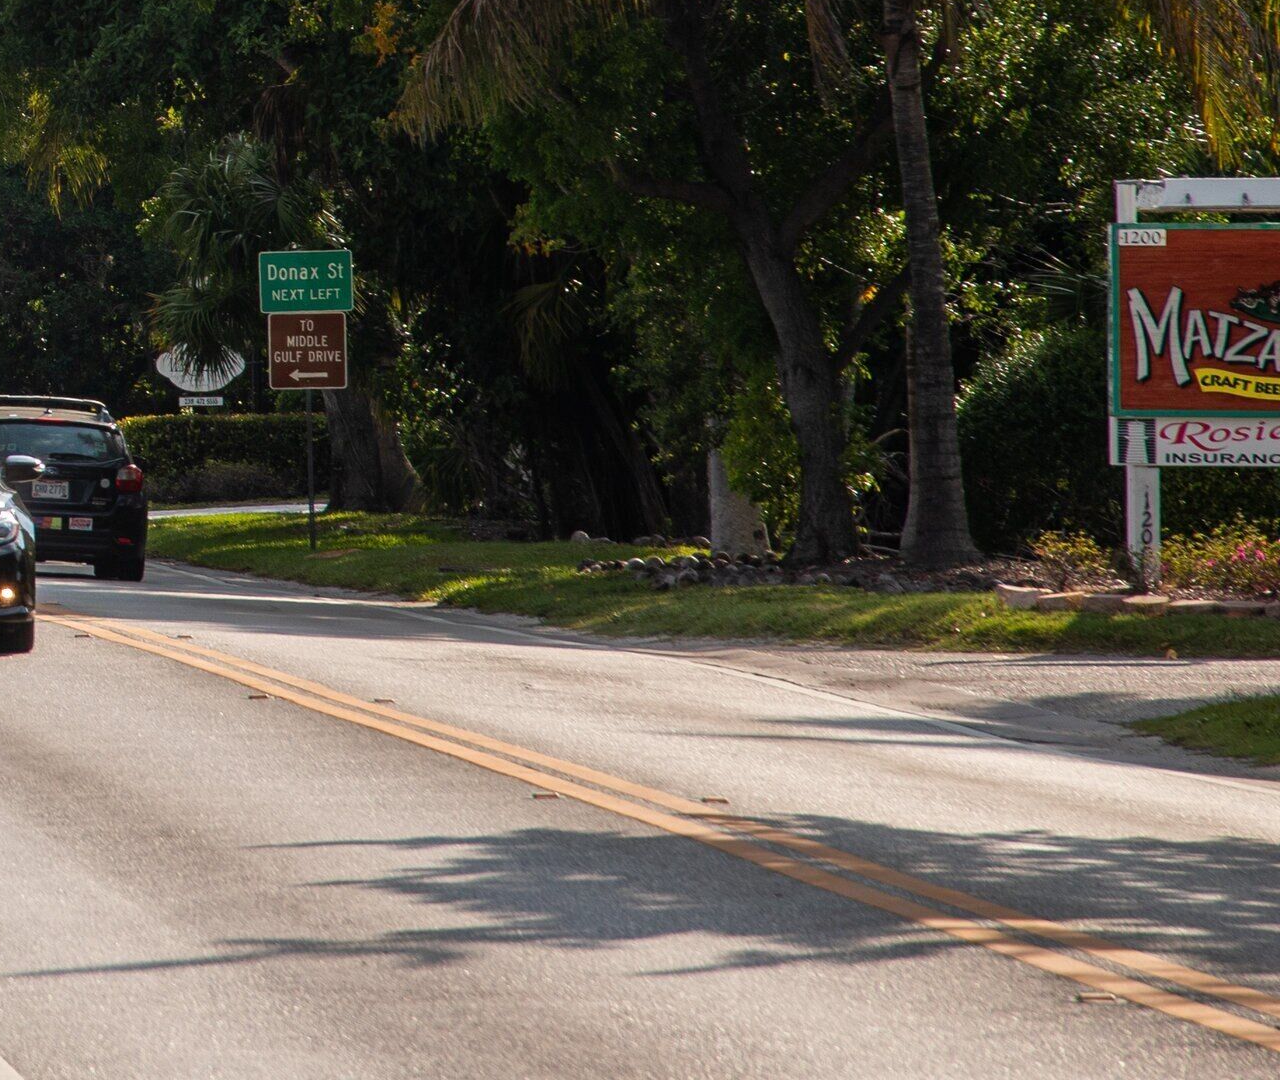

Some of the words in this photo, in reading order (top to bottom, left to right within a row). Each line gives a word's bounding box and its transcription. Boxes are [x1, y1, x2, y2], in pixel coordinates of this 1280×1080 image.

[1123, 231, 1161, 244] 1200
[267, 264, 319, 281] Donax
[327, 262, 344, 279] St
[272, 289, 305, 301] NEXT
[310, 288, 341, 300] LEFT
[300, 320, 314, 331] TO
[286, 335, 328, 347] MIDDLE
[274, 351, 302, 363] GULF
[308, 350, 342, 362] DRIVE
[1201, 375, 1251, 391] CRAFT
